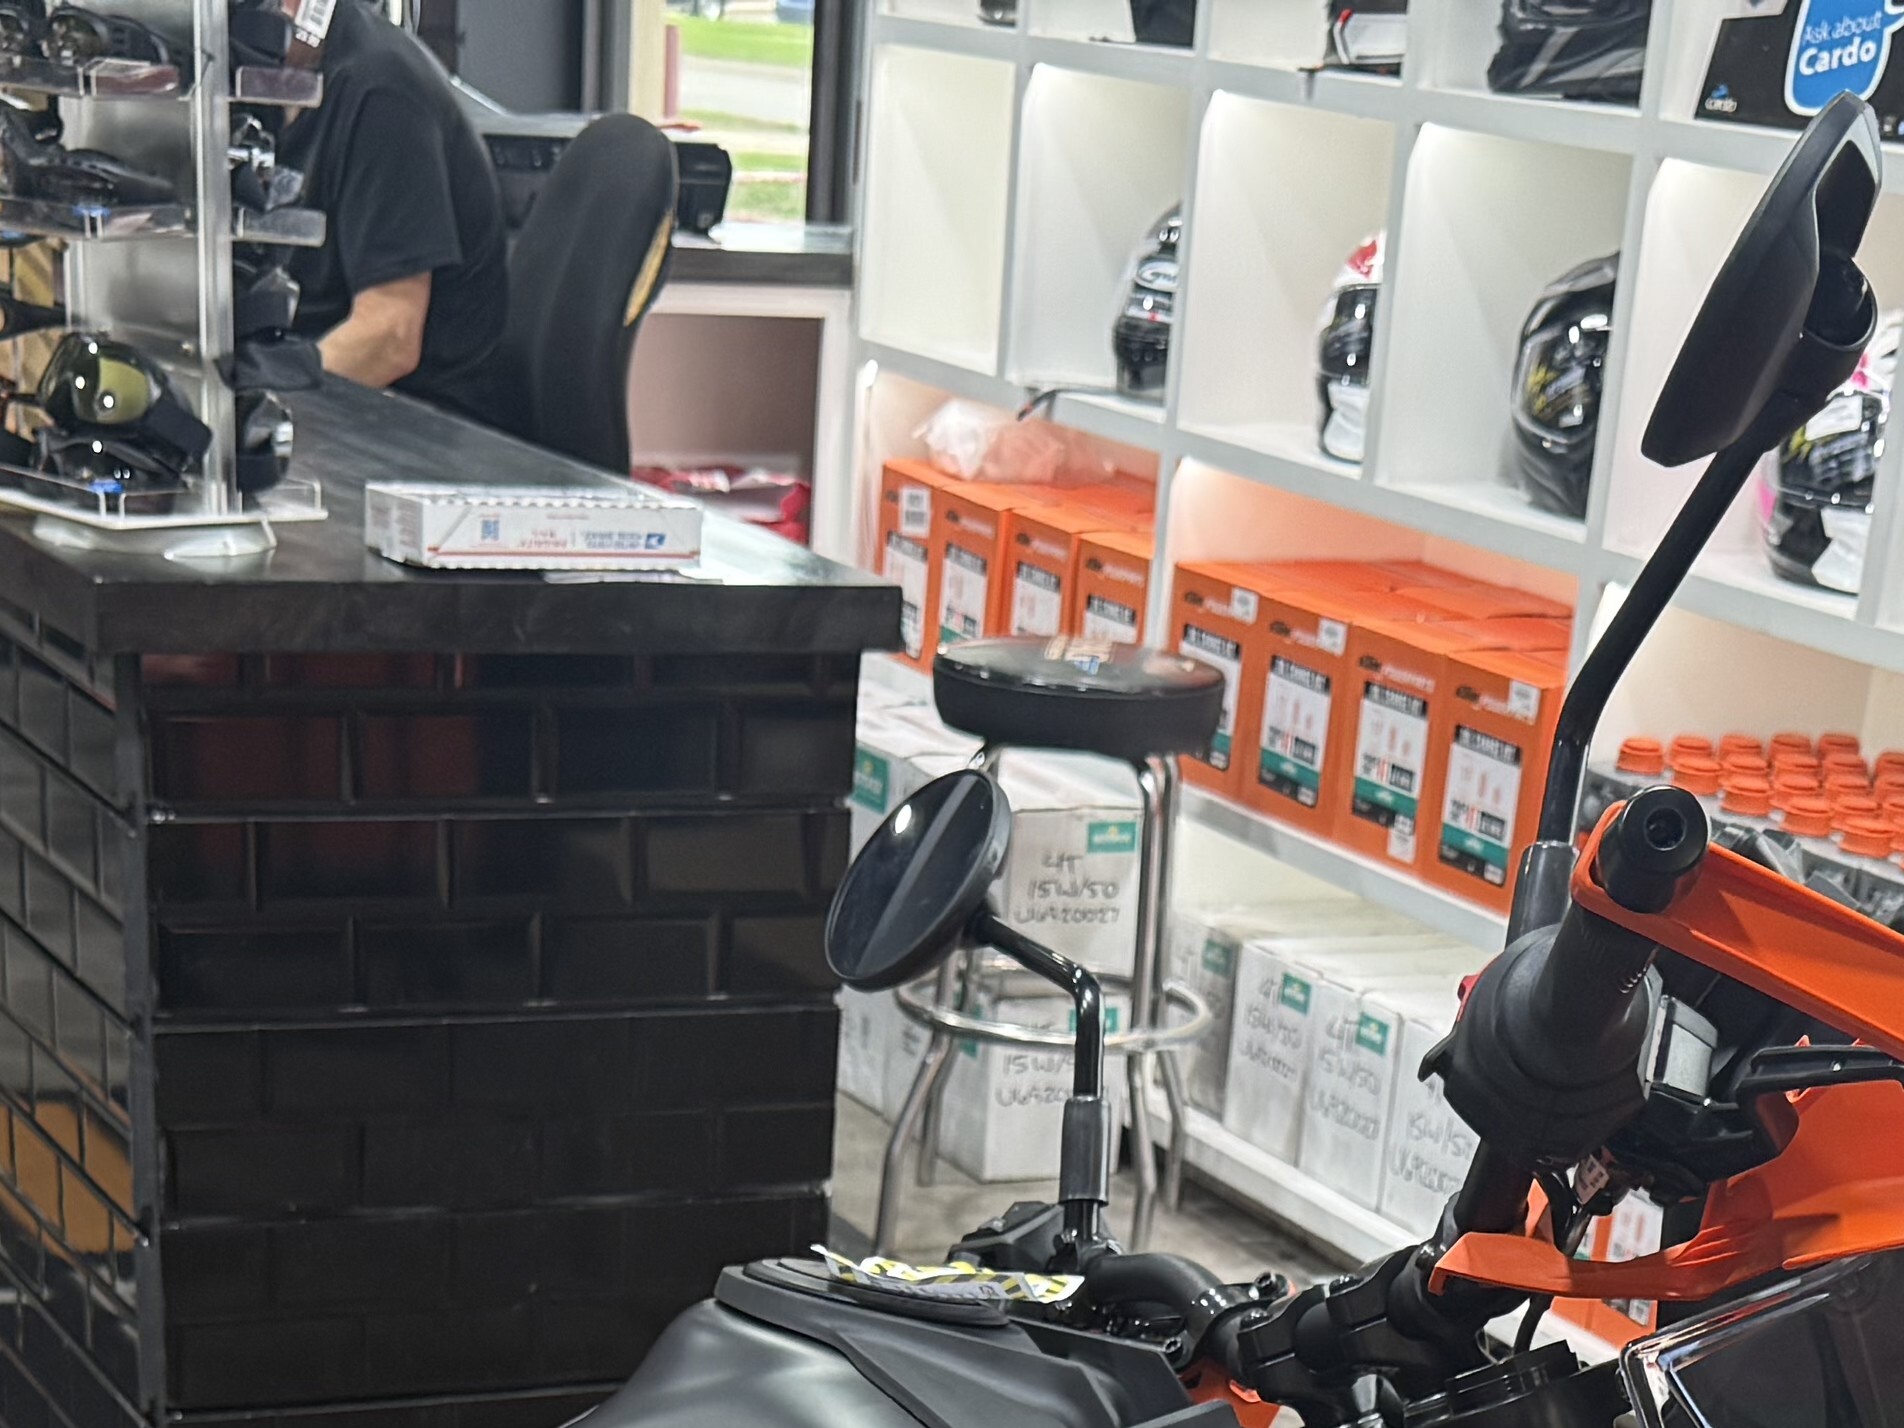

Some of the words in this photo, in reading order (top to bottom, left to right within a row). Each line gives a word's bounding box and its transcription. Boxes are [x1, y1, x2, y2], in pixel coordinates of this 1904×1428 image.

[1801, 25, 1831, 46] Ask
[1832, 11, 1883, 39] about
[1798, 36, 1877, 76] Cardo
